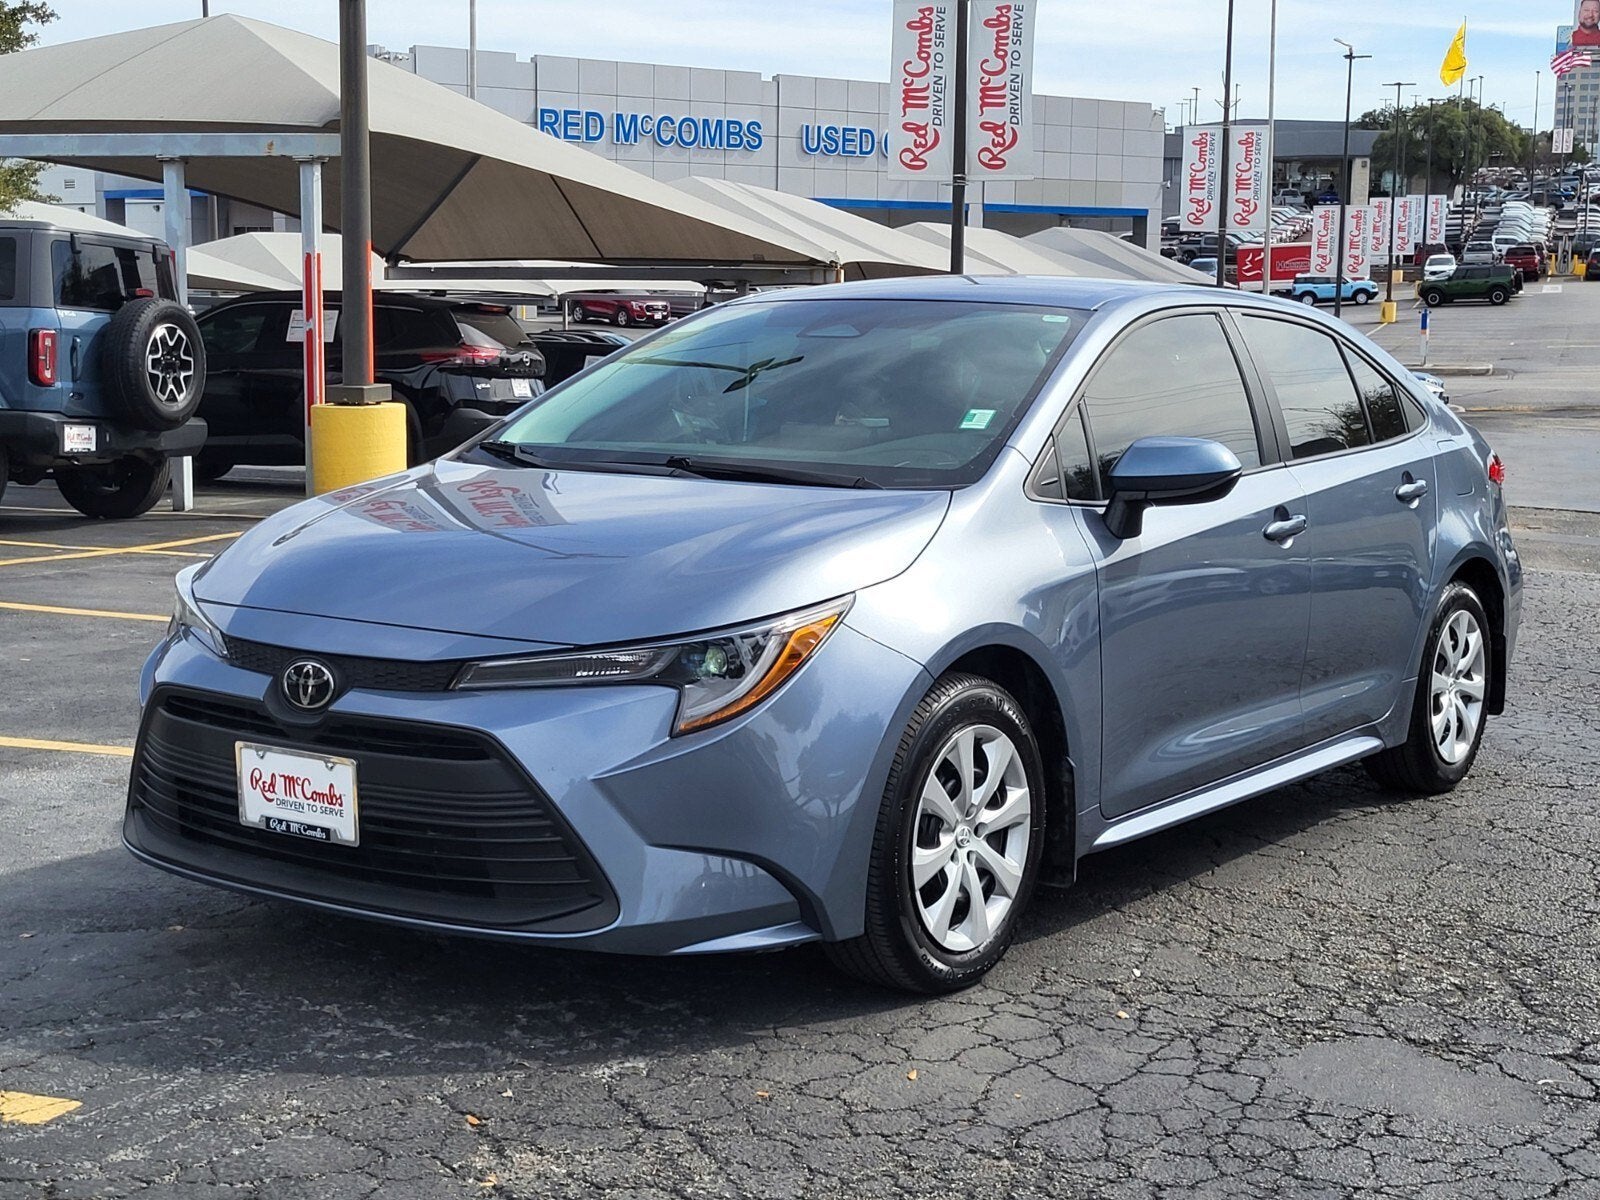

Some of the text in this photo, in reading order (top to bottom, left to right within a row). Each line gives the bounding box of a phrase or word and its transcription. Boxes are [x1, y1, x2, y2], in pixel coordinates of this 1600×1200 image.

[899, 6, 941, 171] Red McCombs
[932, 6, 946, 127] DRIVEN TO SERVE
[977, 4, 1018, 170] Red McCombs
[1009, 4, 1024, 126] DRIVEN TO SERVE
[539, 108, 605, 142] RED
[614, 113, 763, 151] McCOMBS
[802, 123, 876, 157] USED
[1254, 158, 1261, 170] TO
[1187, 132, 1212, 226] Red McCombs
[1208, 159, 1215, 170] TO
[1233, 132, 1258, 226] Red McCombs
[1315, 210, 1332, 273] Red McCombs
[1347, 210, 1364, 273] Red McCombs
[250, 767, 343, 808] Red McCombs
[275, 797, 345, 818] DRIVEN TO SERVE
[288, 822, 326, 839] McCombs
